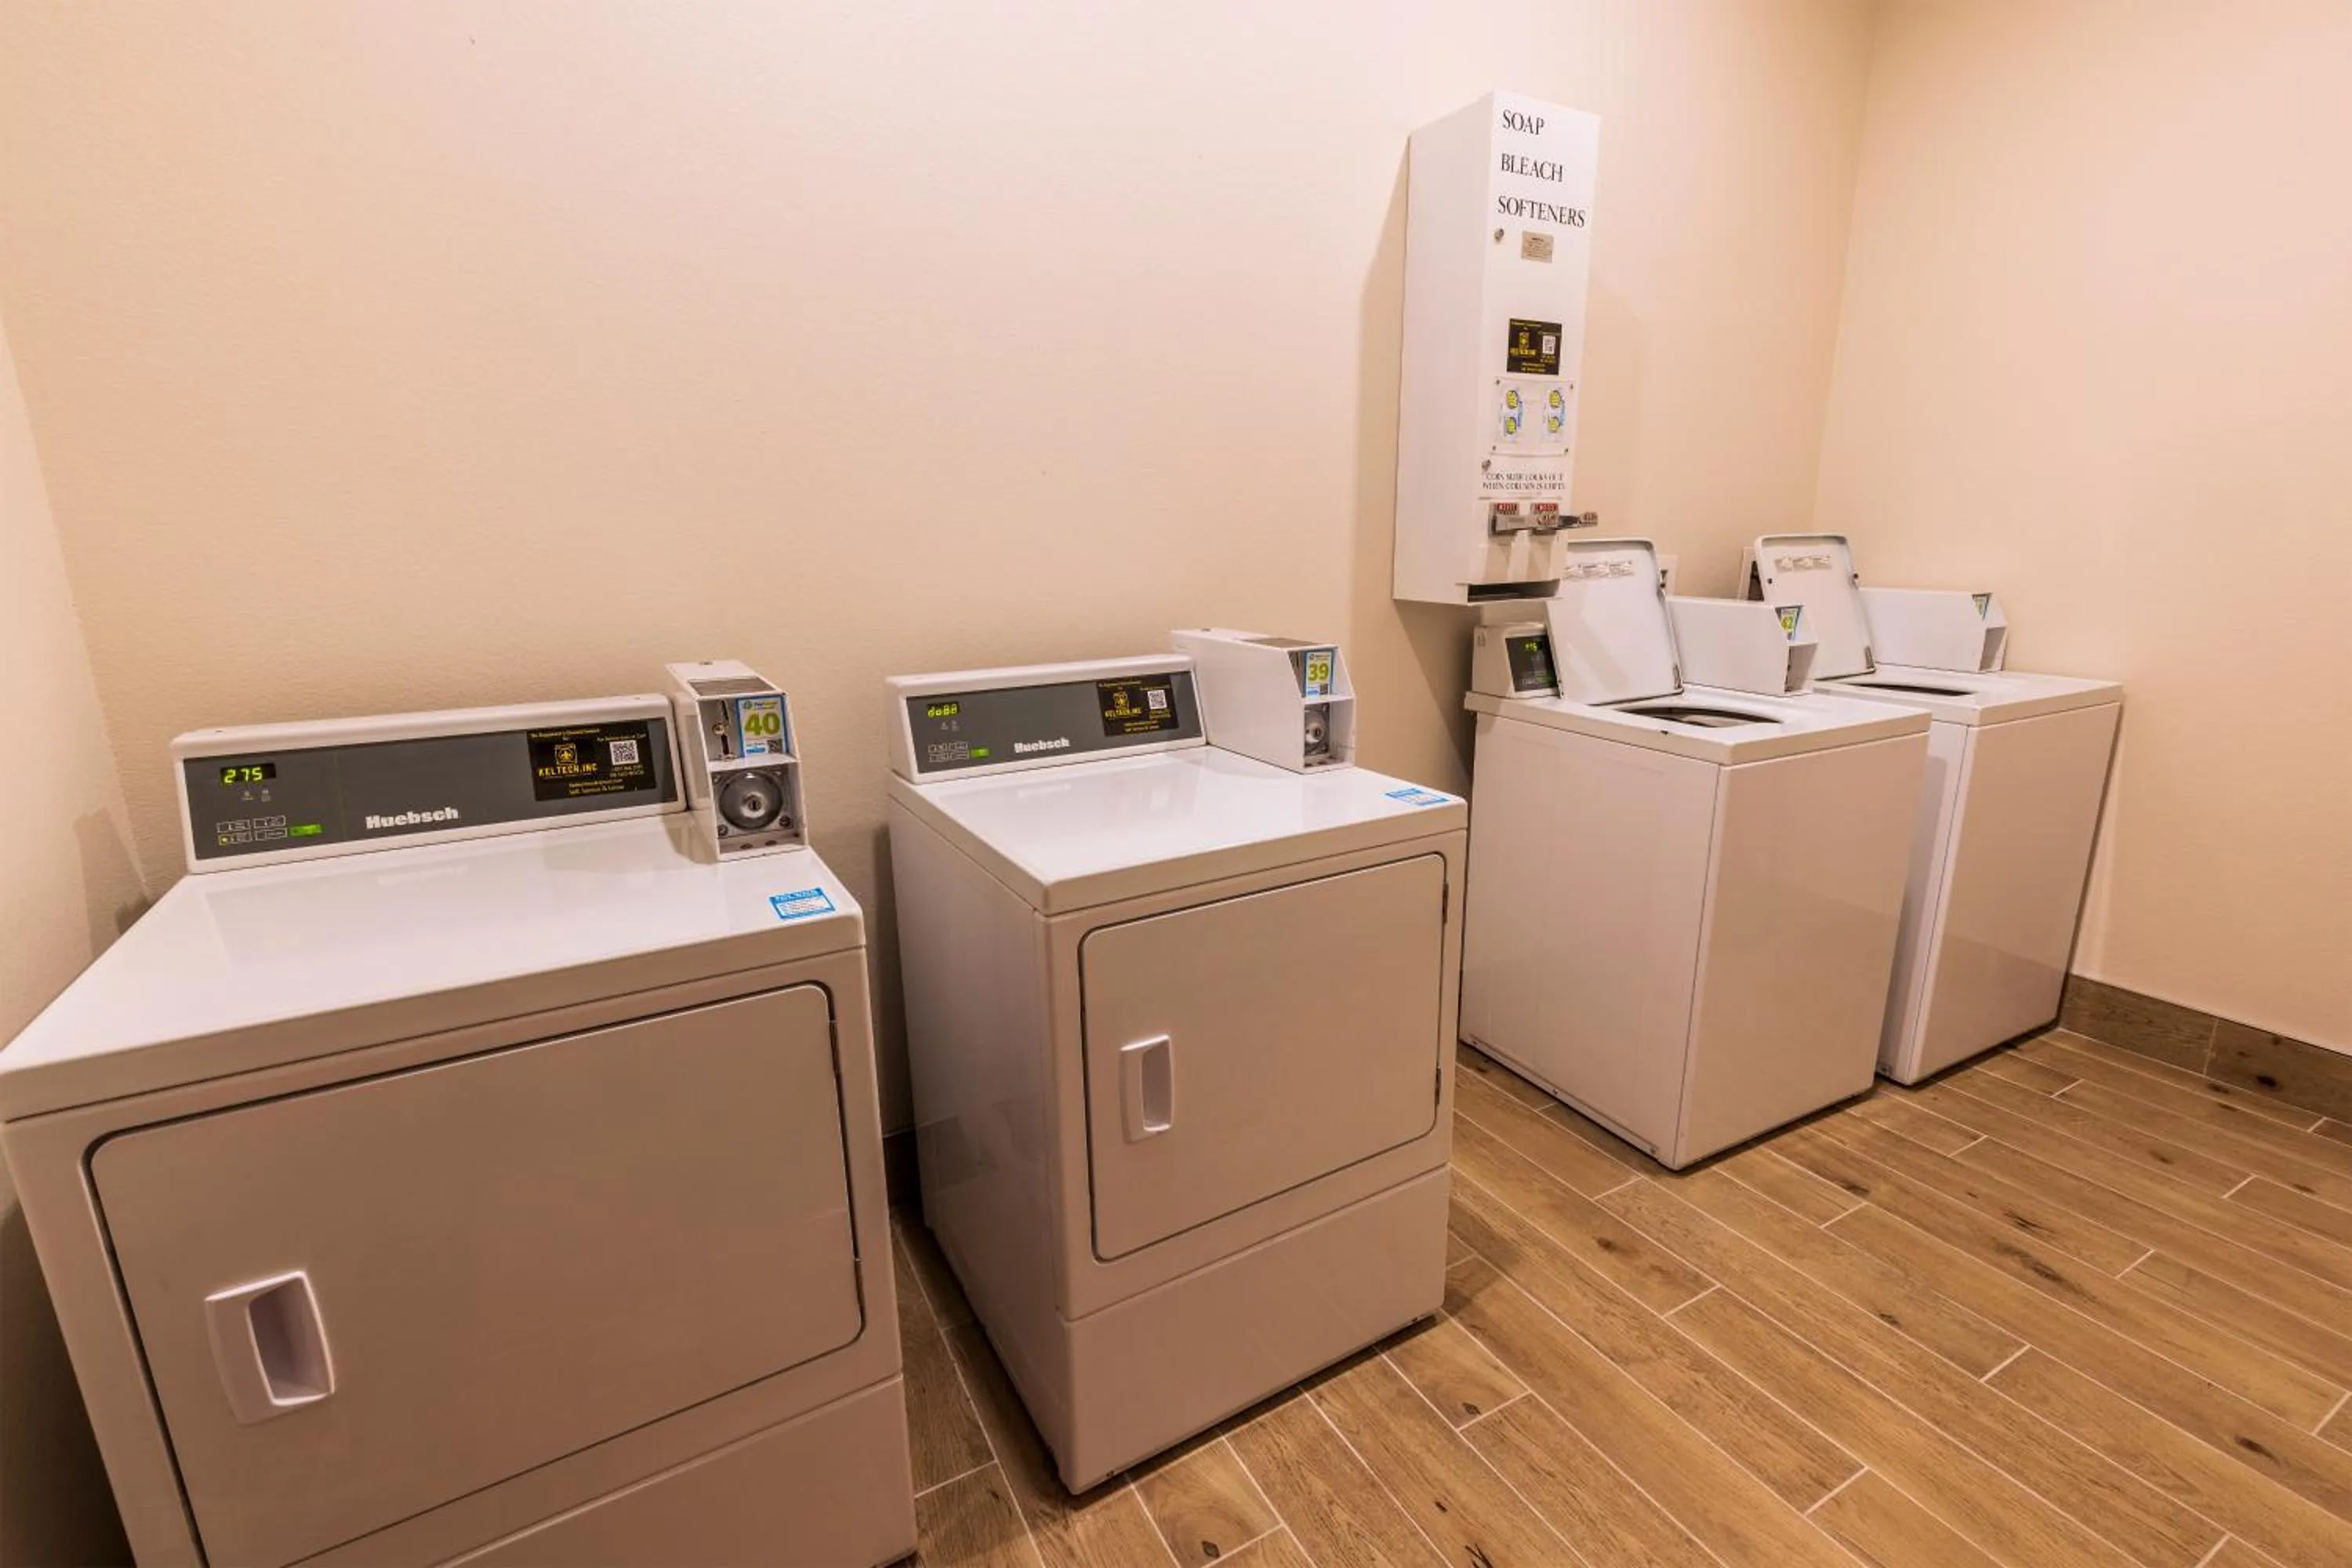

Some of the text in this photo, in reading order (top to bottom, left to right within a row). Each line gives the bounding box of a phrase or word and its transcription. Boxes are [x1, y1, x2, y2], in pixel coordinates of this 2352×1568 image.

[1502, 109, 1544, 136] SOAP
[1501, 153, 1563, 183] BLEACH
[1497, 195, 1586, 228] SOFTENERS
[1308, 662, 1329, 681] 39
[745, 712, 780, 735] 40
[1014, 736, 1071, 753] Huebsch
[223, 767, 263, 783] 275
[365, 807, 459, 829] Huebsch
